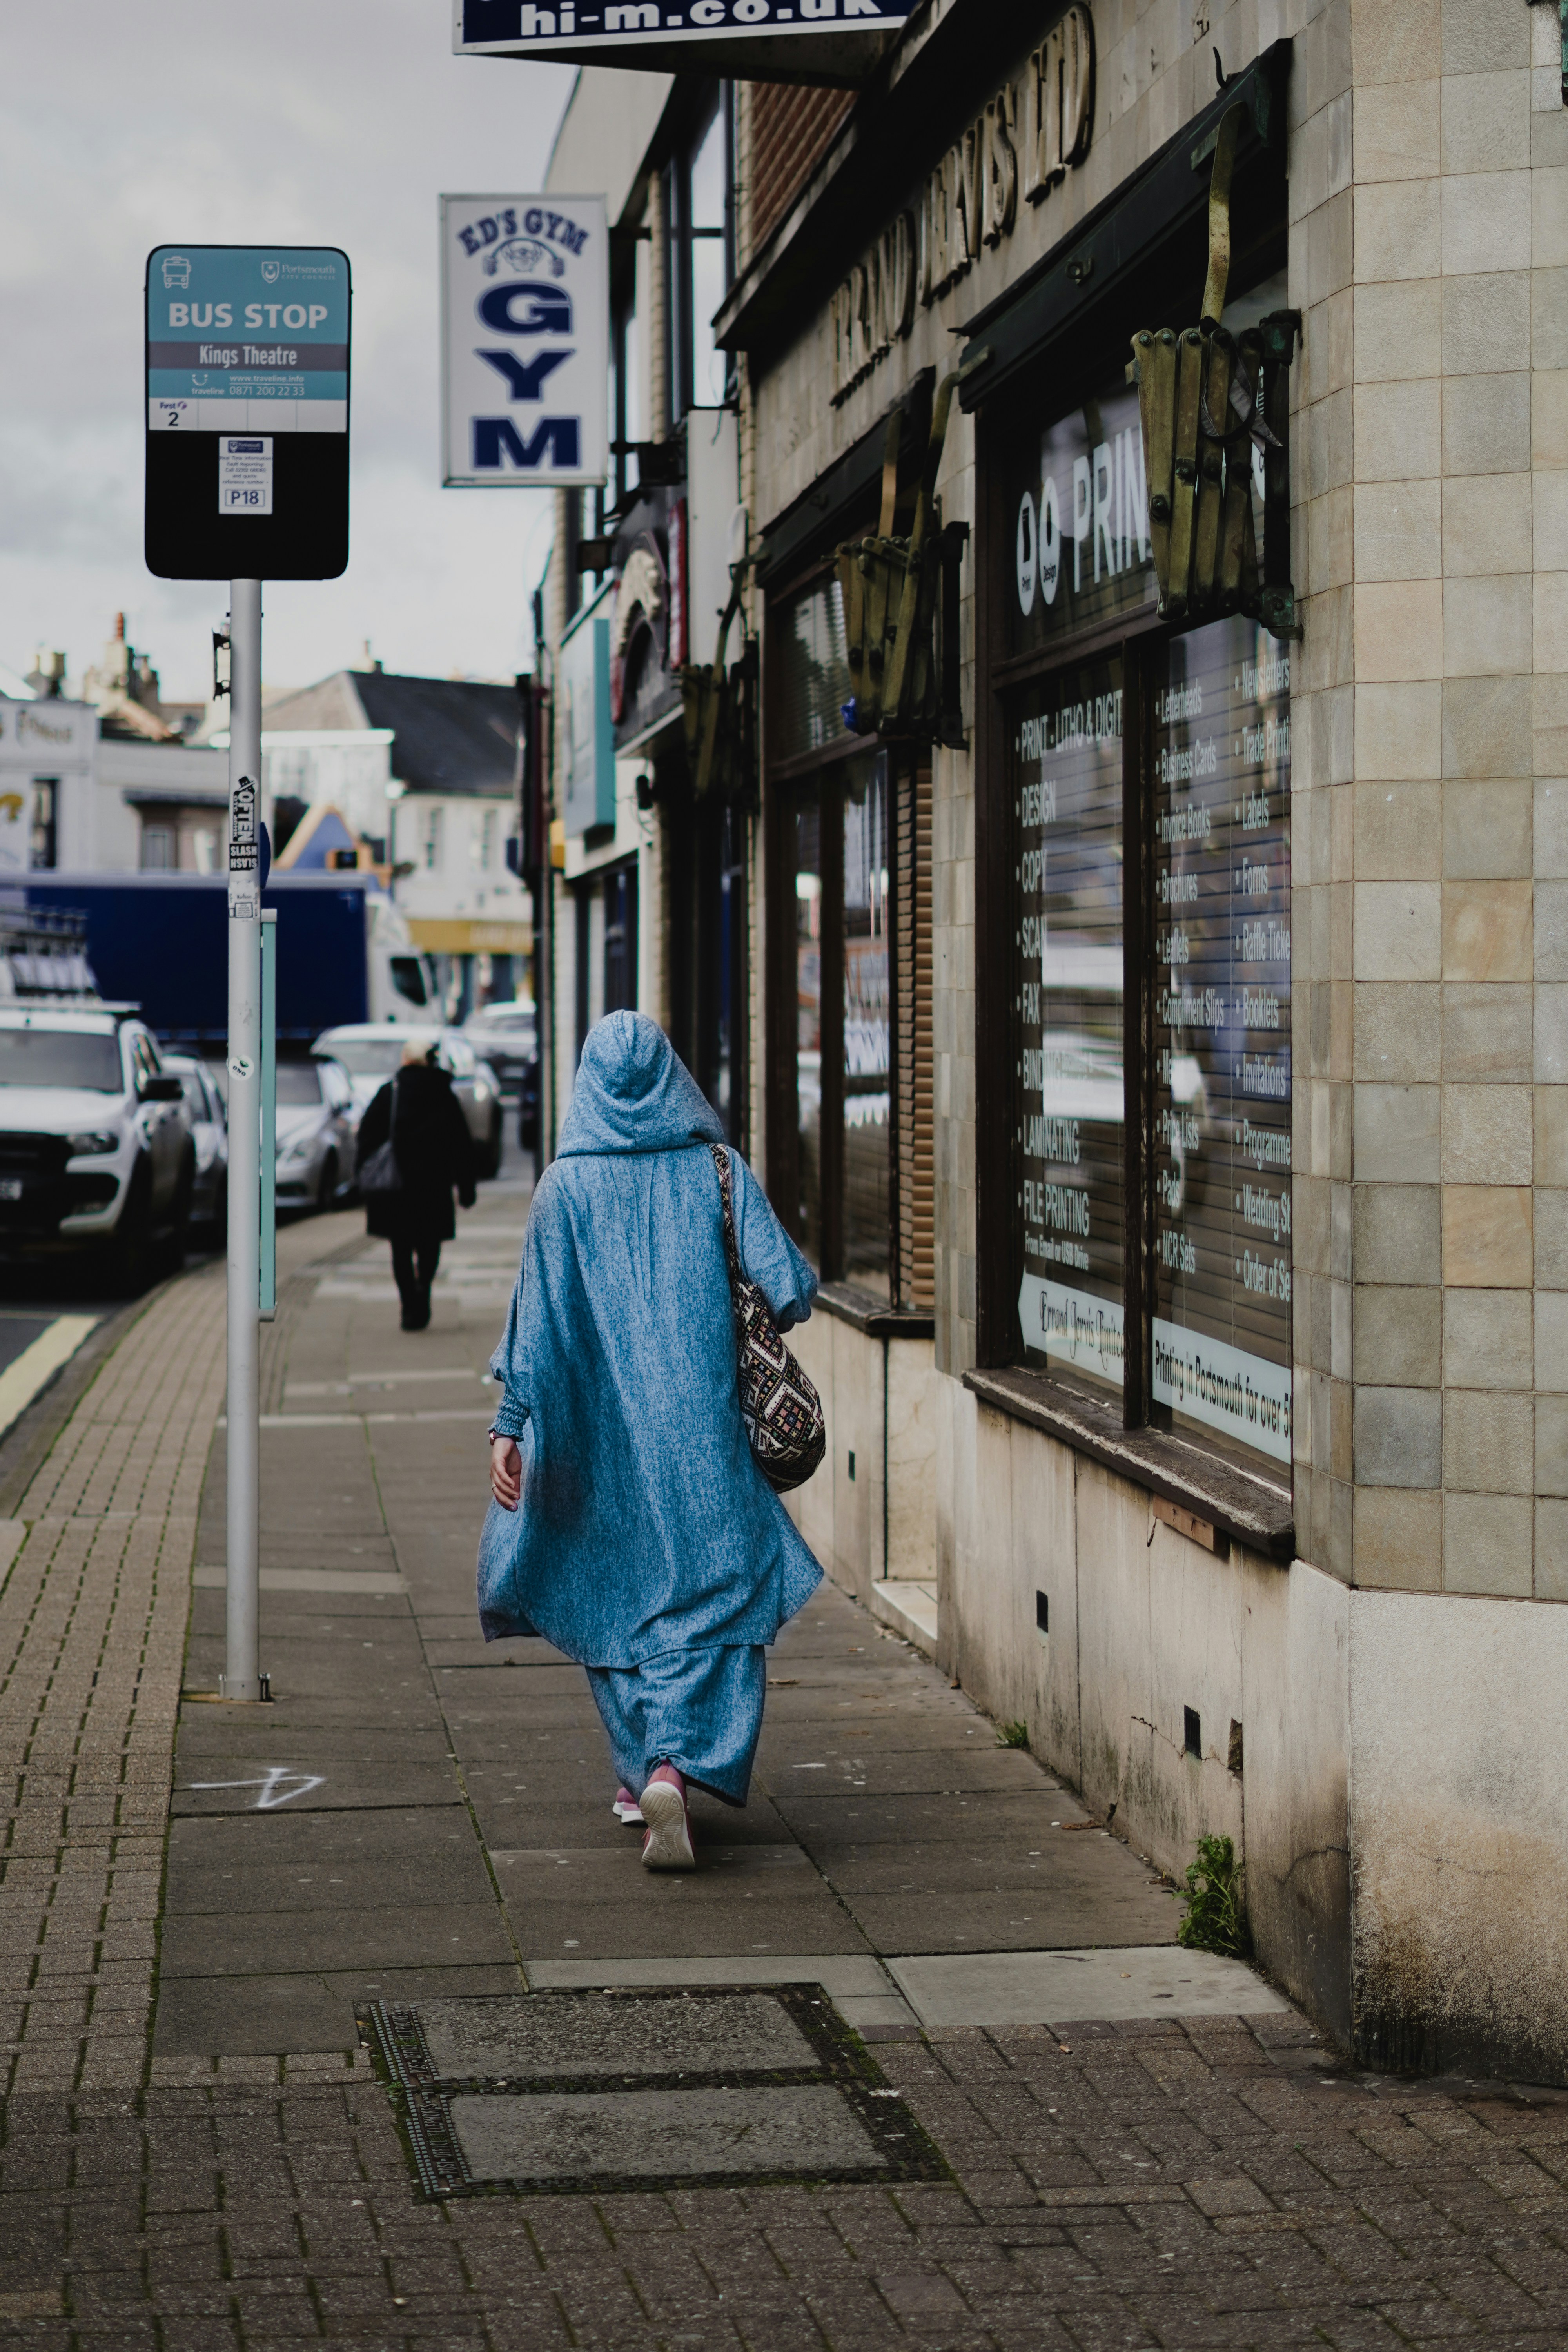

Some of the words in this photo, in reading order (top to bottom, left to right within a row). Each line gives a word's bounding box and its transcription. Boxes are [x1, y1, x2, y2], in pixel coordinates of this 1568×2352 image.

[1025, 3, 1096, 202] LTD
[456, 208, 518, 258] ED'S
[524, 208, 590, 257] GYM
[282, 263, 336, 274] Portsmouth
[169, 303, 233, 328] BUS
[244, 304, 328, 329] STOP
[200, 345, 238, 368] Kings
[243, 345, 298, 366] Theatre
[470, 279, 582, 470] GYM
[229, 386, 253, 396] 0871
[256, 387, 276, 396] 200
[278, 387, 290, 396] 22
[292, 387, 305, 396] 33
[168, 412, 179, 426] 2
[231, 490, 259, 505] P18
[1021, 575, 1031, 593] Print
[1043, 564, 1057, 584] Design
[1242, 654, 1290, 700] Newsletters
[1161, 679, 1201, 724] Letterheads
[1022, 714, 1048, 762] PRINT
[1056, 703, 1083, 753] LITHO
[1086, 700, 1093, 745] &
[1242, 724, 1264, 766] Trade
[1162, 745, 1193, 783] Business
[1195, 737, 1216, 777] Cards
[238, 791, 254, 842] OFTEN
[1022, 780, 1056, 827] DESIGN
[1162, 804, 1186, 844] Invoice
[1188, 801, 1210, 839] Books
[1243, 789, 1269, 831] Labels
[230, 846, 257, 856] SLASH
[230, 858, 258, 869] SLASH
[1022, 849, 1047, 893] COPY
[1162, 867, 1198, 904] Brochures
[1243, 857, 1268, 896] Forms
[1022, 916, 1047, 959] SCAN
[1162, 927, 1189, 964] Leaflets
[1243, 921, 1266, 962] Raffle
[1268, 920, 1290, 961] Ticke
[1022, 982, 1041, 1024] FAX
[1163, 989, 1204, 1034] Compliment
[1205, 988, 1224, 1035] Slips
[1243, 988, 1278, 1029] Booklets
[1243, 1053, 1285, 1096] Invitations
[1023, 1115, 1079, 1164] LAMINATING
[1163, 1109, 1180, 1146] Price
[1182, 1112, 1199, 1150] Lists
[1243, 1118, 1290, 1171] Programme
[1024, 1180, 1044, 1225] FILE
[1045, 1184, 1089, 1237] PRINTING
[1163, 1169, 1180, 1208] Pads
[1243, 1184, 1279, 1241] Wedding
[1025, 1231, 1038, 1256] From
[1039, 1234, 1054, 1261] Email
[1054, 1244, 1061, 1262] or
[1062, 1239, 1073, 1266] USB
[1074, 1244, 1089, 1272] Drive
[1163, 1230, 1178, 1269] NCR
[1180, 1234, 1196, 1274] Sets
[1243, 1249, 1266, 1294] Order
[1268, 1257, 1278, 1297] of
[1040, 1291, 1068, 1337] Errand
[1155, 1340, 1183, 1402] Printing
[1186, 1352, 1193, 1394] in
[1196, 1355, 1243, 1417] Portsmouth
[1246, 1376, 1258, 1423] for
[1261, 1394, 1281, 1434] over
